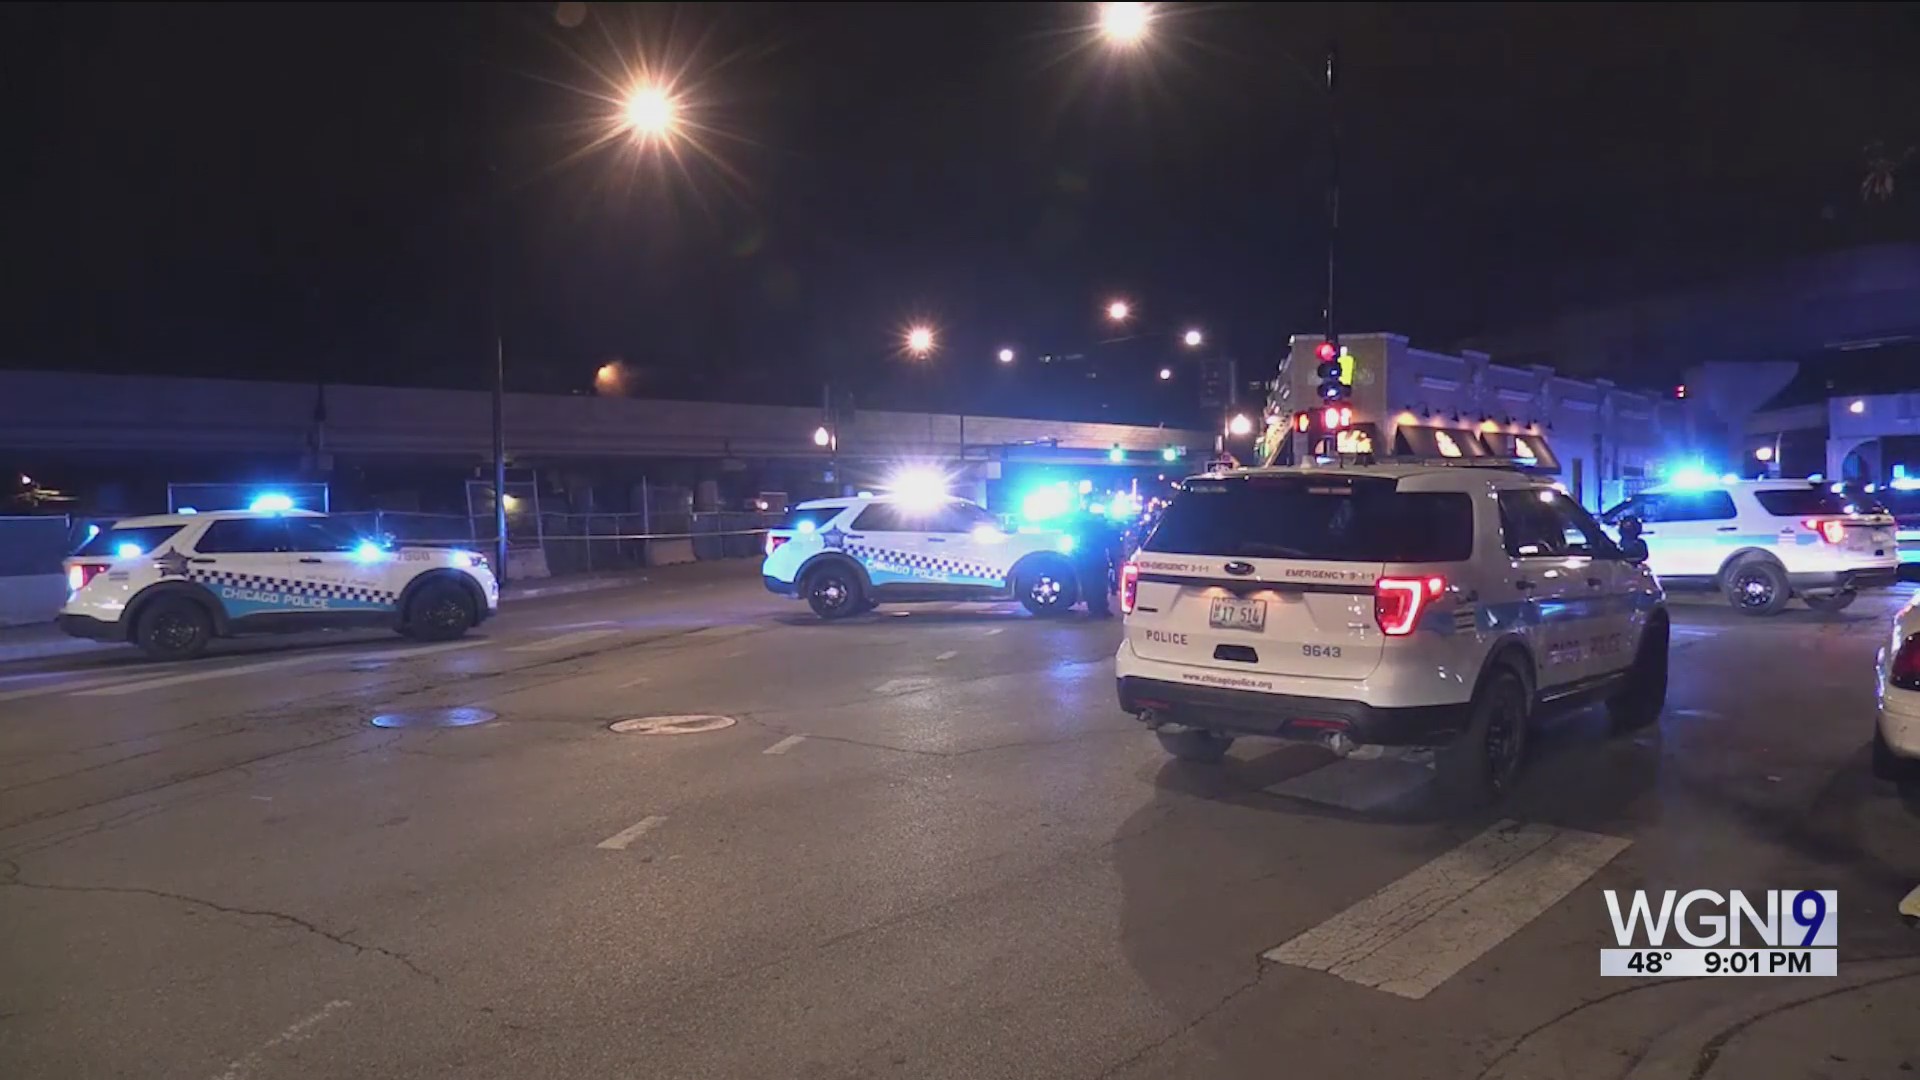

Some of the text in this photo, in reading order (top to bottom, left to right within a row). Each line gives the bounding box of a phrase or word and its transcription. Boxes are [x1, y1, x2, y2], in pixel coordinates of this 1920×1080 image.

[1285, 568, 1345, 579] EMERGENCY
[221, 586, 329, 609] CHICAGO POLICE
[1146, 630, 1189, 645] POLICE
[1302, 644, 1342, 658] 9643
[1182, 672, 1273, 689] www.chicagopolice.org
